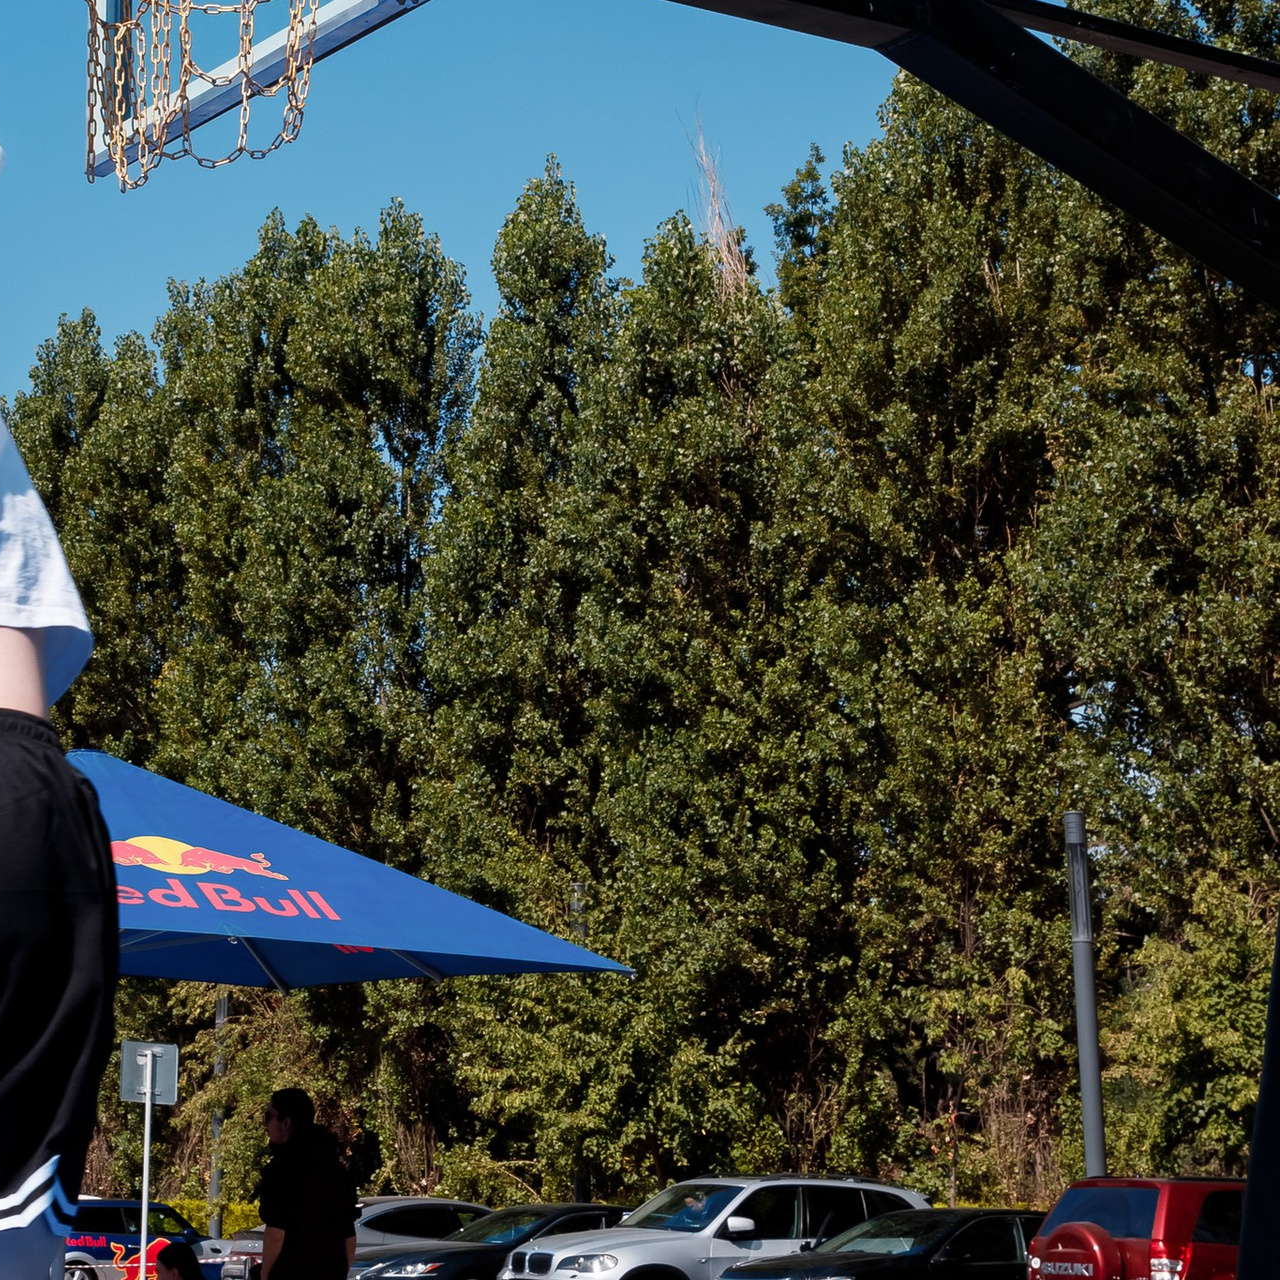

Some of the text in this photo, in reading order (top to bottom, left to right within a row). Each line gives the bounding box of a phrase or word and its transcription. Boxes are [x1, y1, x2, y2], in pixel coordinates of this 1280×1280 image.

[116, 878, 342, 921] ed Bull
[85, 1235, 107, 1247] Bull
[1041, 1262, 1094, 1277] SUZUKI
